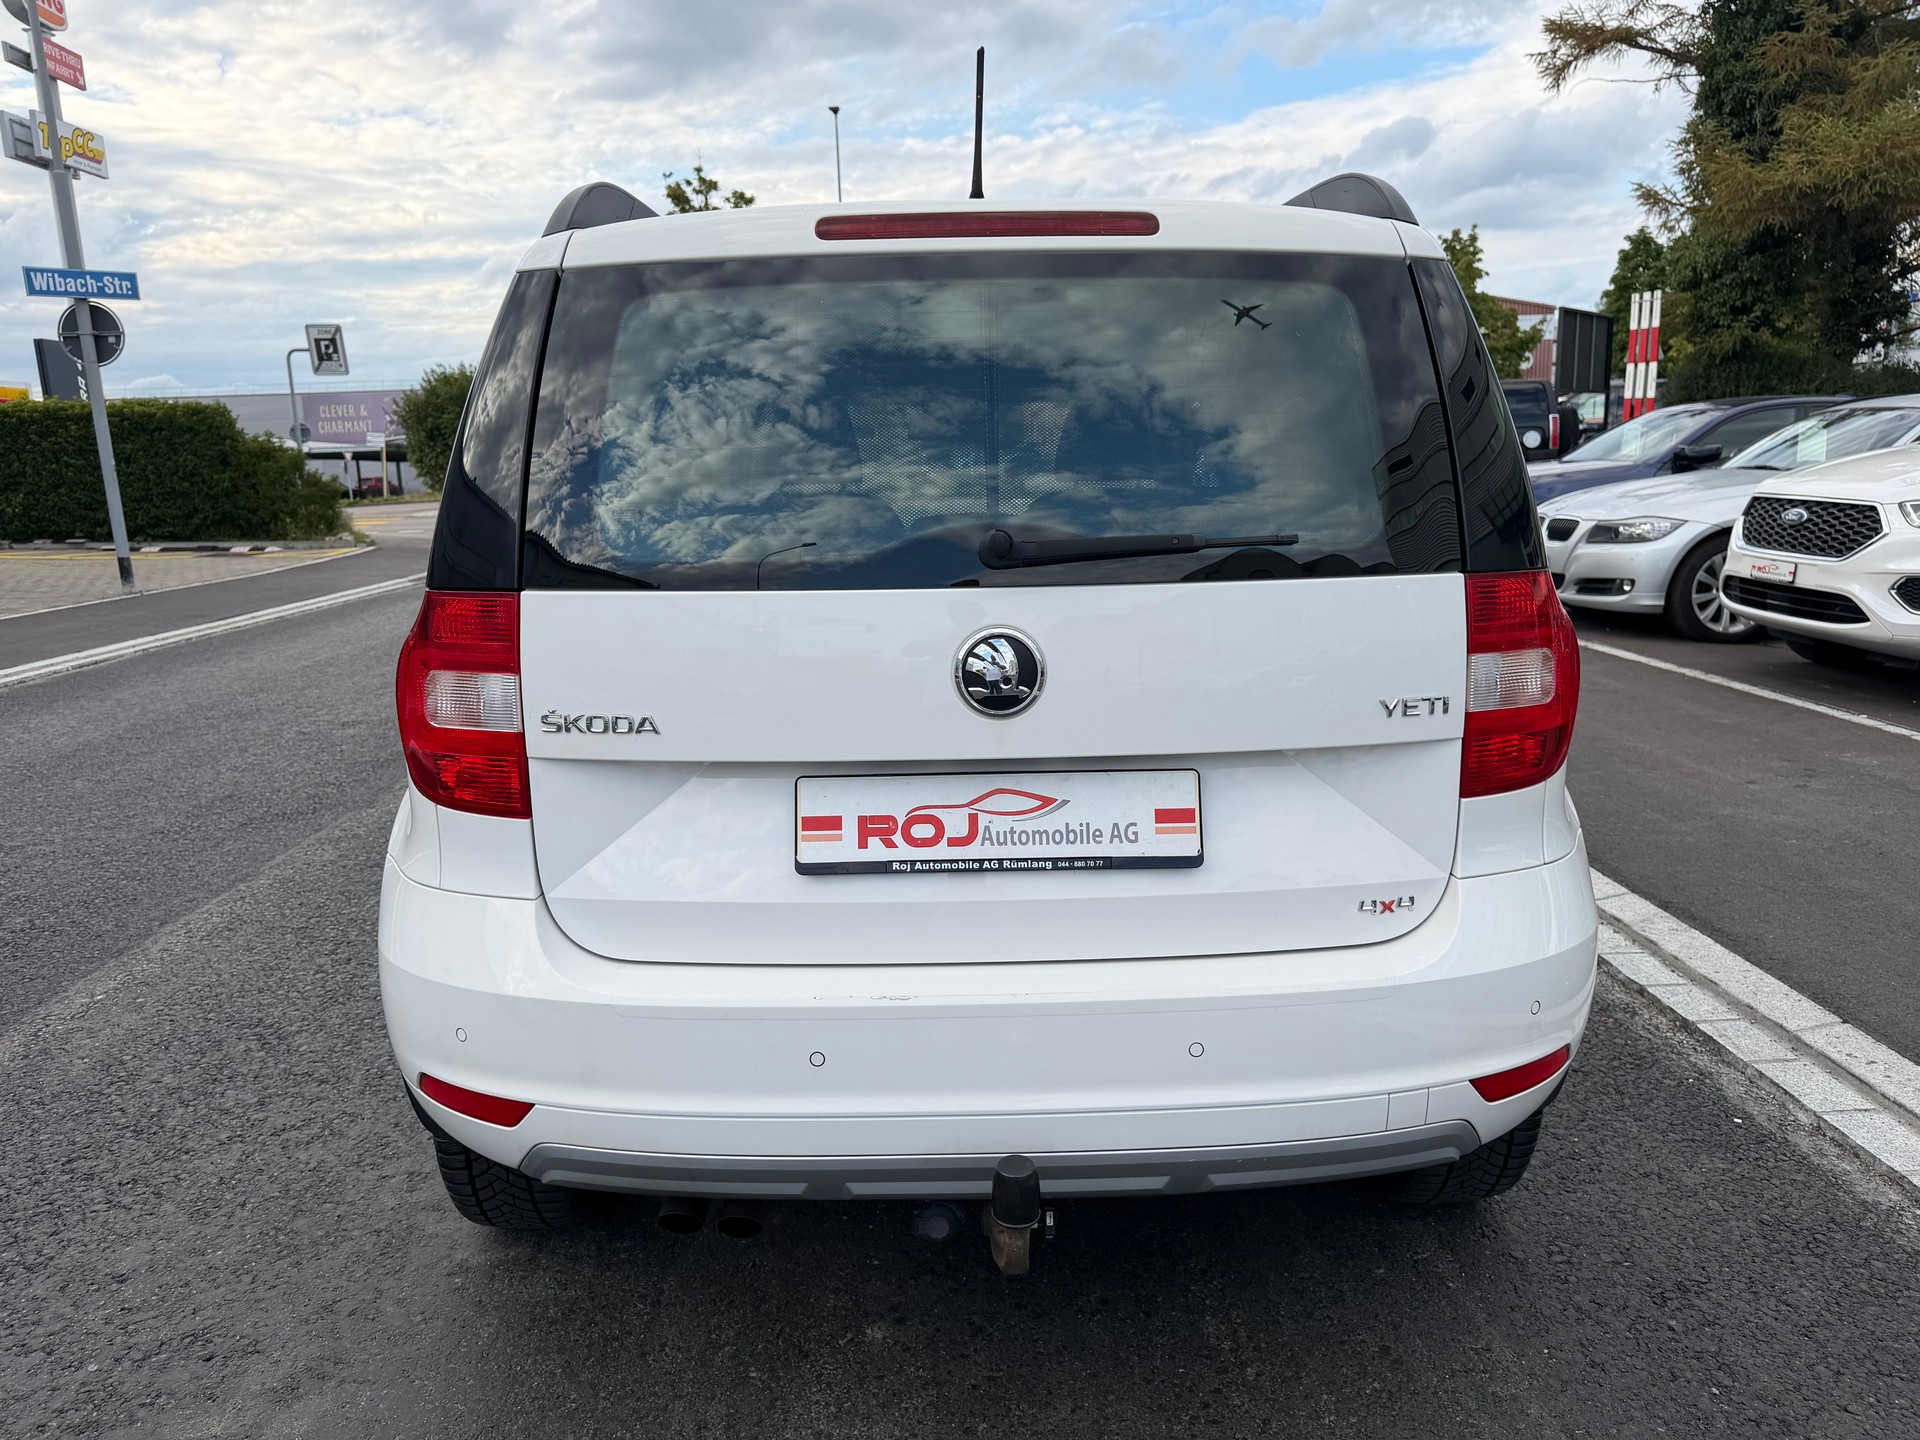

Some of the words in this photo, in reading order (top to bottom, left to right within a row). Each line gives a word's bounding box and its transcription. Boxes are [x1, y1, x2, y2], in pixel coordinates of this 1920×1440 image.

[38, 121, 96, 163] TpCC
[30, 271, 132, 295] Wibach-Str.
[320, 404, 356, 418] CLEVER
[360, 403, 368, 417] &
[318, 419, 374, 434] CHARMANT
[1379, 696, 1450, 719] YETI
[540, 709, 661, 735] ŠKODA
[857, 813, 979, 849] ROJ
[980, 822, 1104, 847] Automobile
[1109, 822, 1139, 844] AG
[892, 862, 911, 872] Roj
[914, 861, 980, 870] Automobile
[982, 860, 999, 869] AG
[1003, 860, 1053, 870] Rümlang
[1358, 896, 1415, 915] 4x4
